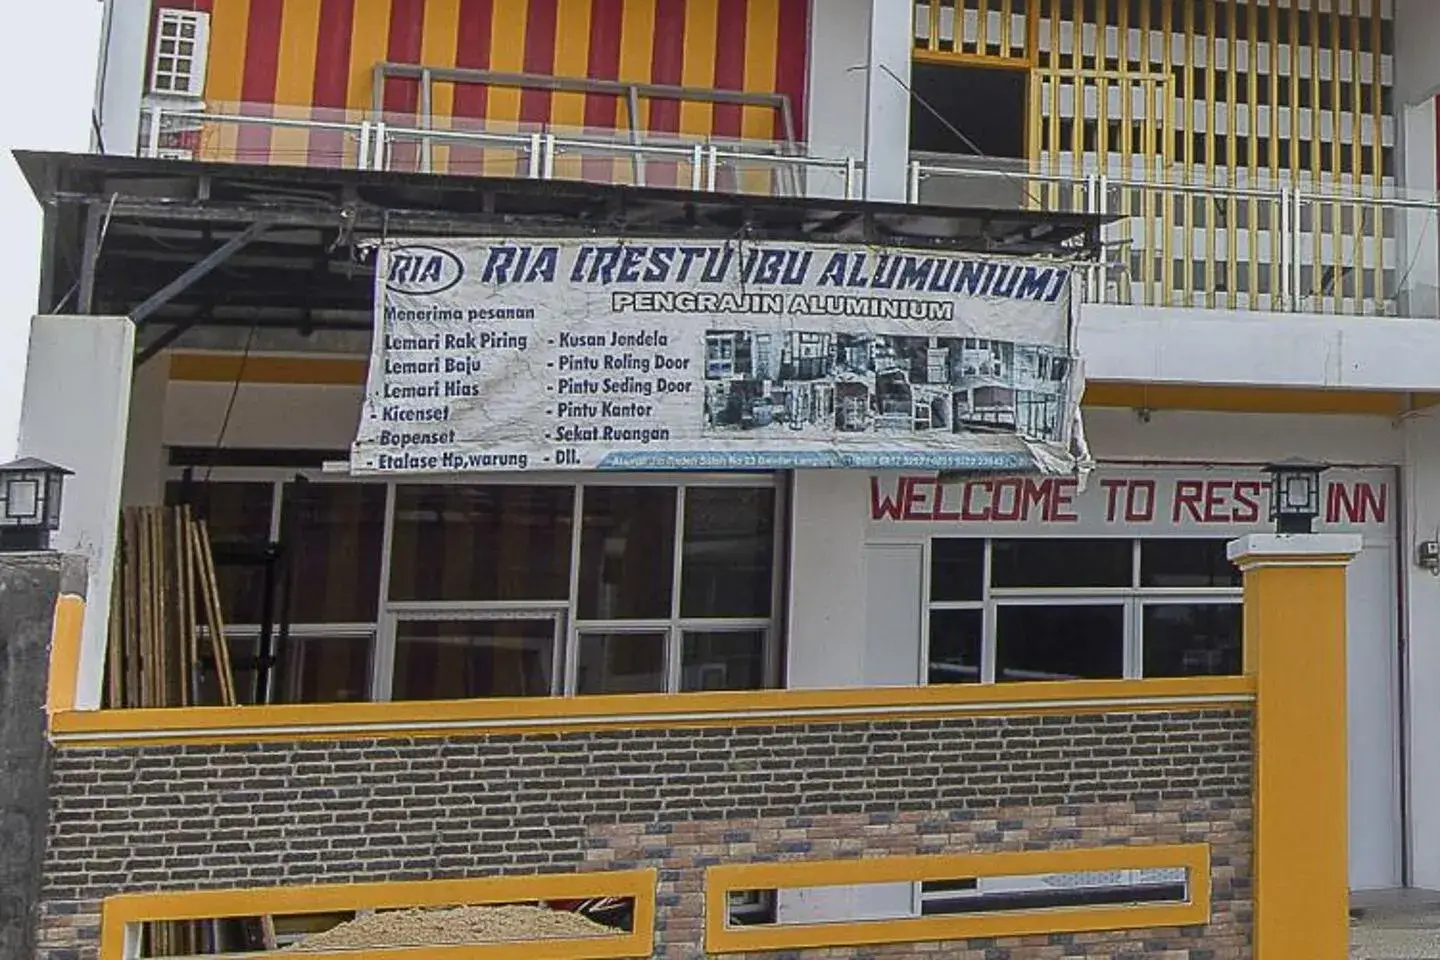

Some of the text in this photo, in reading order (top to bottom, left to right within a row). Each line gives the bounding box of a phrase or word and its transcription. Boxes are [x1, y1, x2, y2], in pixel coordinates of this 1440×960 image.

[389, 255, 442, 283] RIA
[482, 246, 559, 284] RIA
[743, 248, 812, 285] IBU
[468, 307, 535, 322] pesanan
[612, 292, 954, 321] PENGRAJIN ALUMINIUM
[385, 331, 528, 350] Lemari Rak Piring
[559, 332, 606, 347] Kusan
[384, 356, 481, 375] Lemari Baju
[558, 354, 690, 373] Pintu Roling Door
[383, 381, 480, 398] Lemari Hias
[558, 377, 692, 396] Pintu Seding Door
[558, 401, 653, 417] Pintu Kantor
[556, 425, 670, 444] Sekat Ruangan
[378, 453, 437, 469] Etalase
[870, 477, 1387, 523] WELCOME TO REST INN
